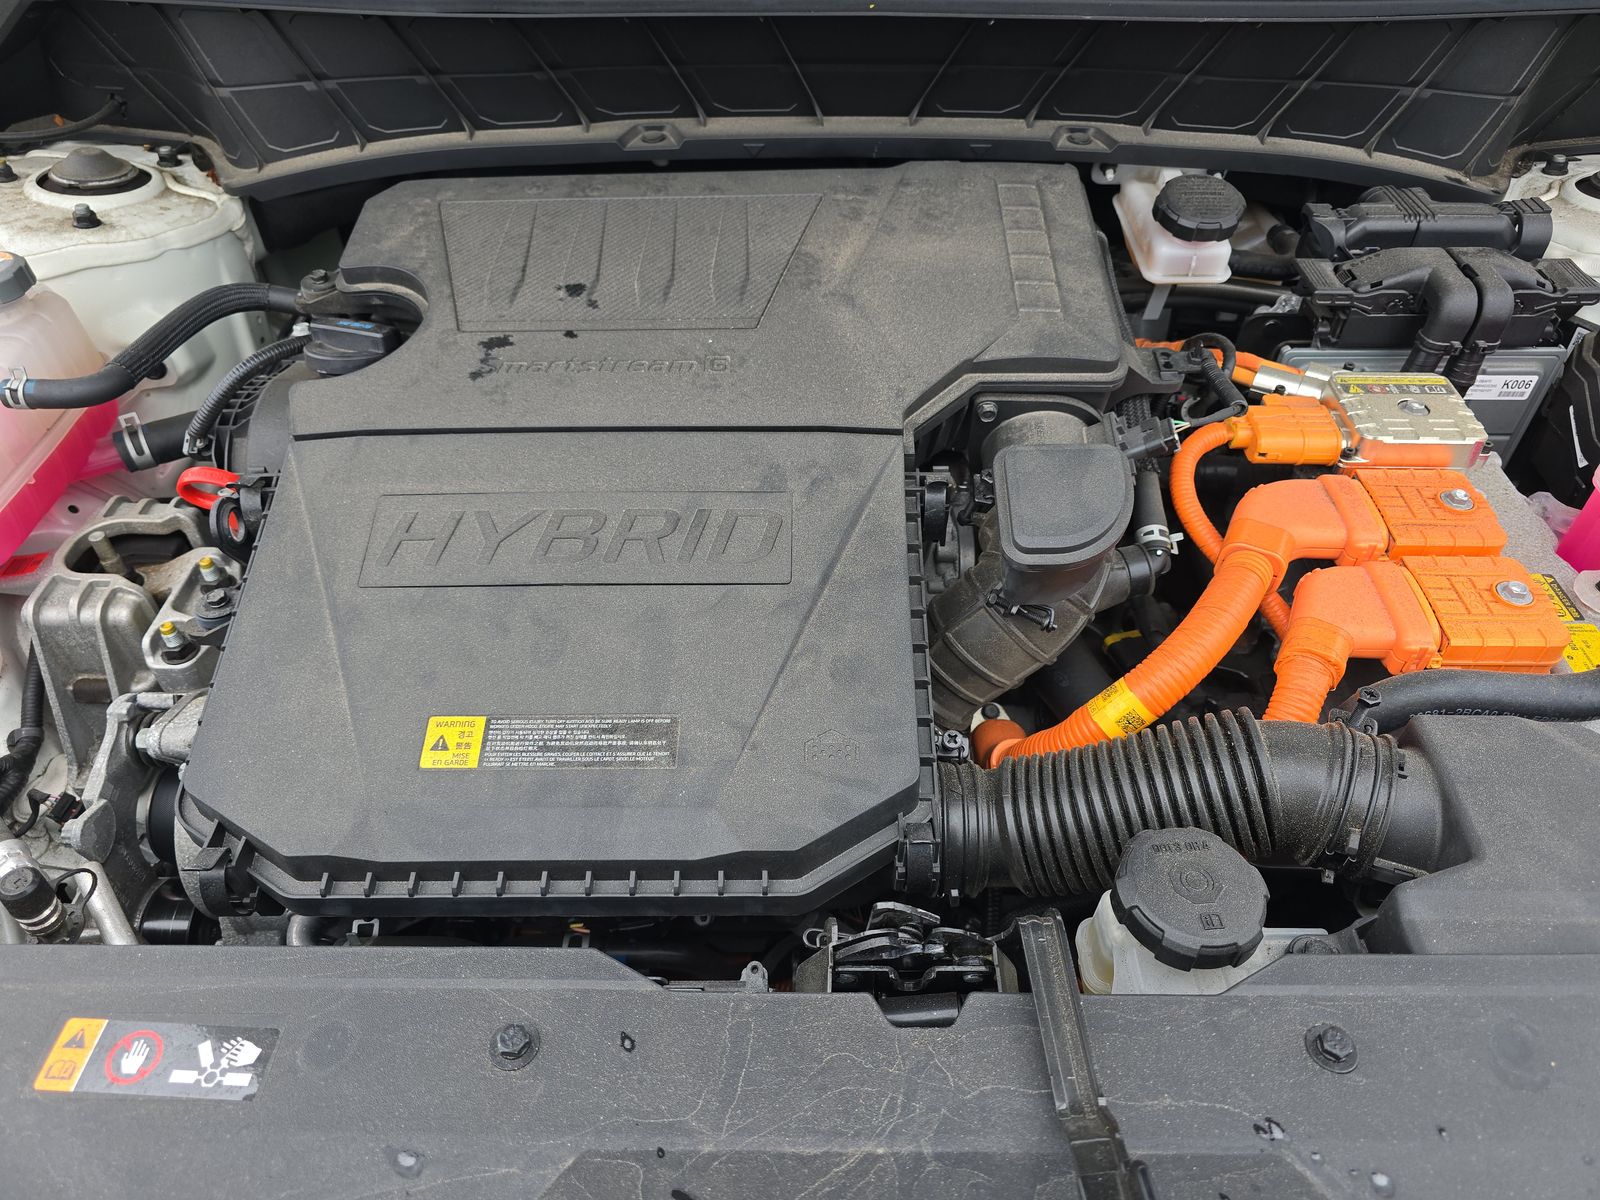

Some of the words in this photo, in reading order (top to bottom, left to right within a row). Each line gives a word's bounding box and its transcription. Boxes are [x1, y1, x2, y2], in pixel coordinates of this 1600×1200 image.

[479, 356, 698, 375] Smartstream
[1501, 379, 1532, 389] K006
[376, 507, 785, 567] HYBRID
